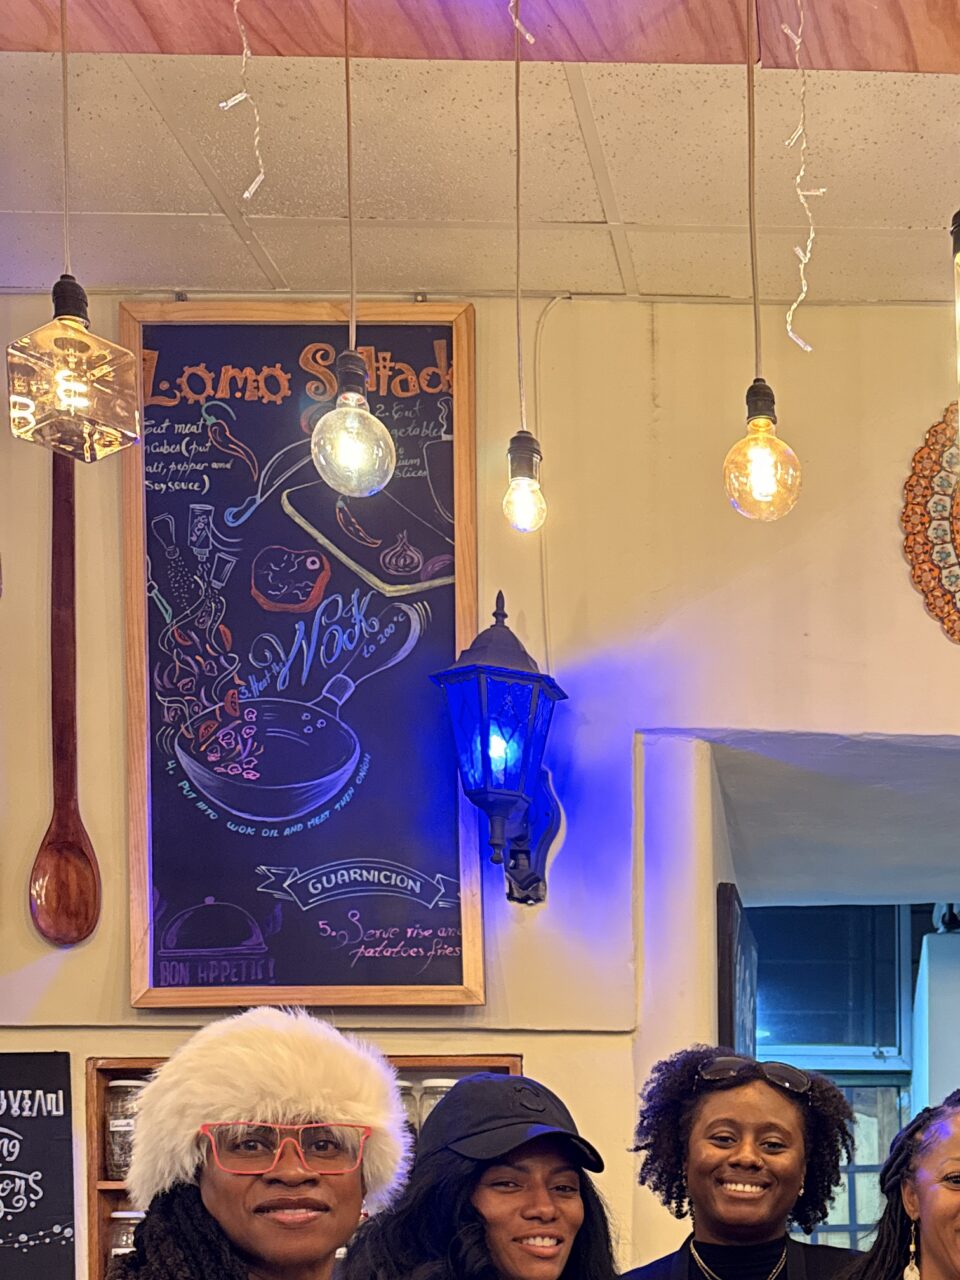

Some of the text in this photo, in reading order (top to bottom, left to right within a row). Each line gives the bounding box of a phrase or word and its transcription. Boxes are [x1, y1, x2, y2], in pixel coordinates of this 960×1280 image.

[143, 339, 453, 406] Lomo Sltad
[174, 417, 205, 434] meat
[145, 462, 167, 476] alt,
[166, 461, 209, 482] pepper
[362, 644, 377, 658] to
[178, 780, 197, 799] PUT
[261, 827, 280, 838] OIL
[283, 823, 304, 837] AND
[307, 809, 331, 829] MEAT
[308, 868, 421, 894] GUARNICION
[318, 920, 337, 937] 5.
[406, 924, 433, 938] rise
[160, 961, 189, 986] BON
